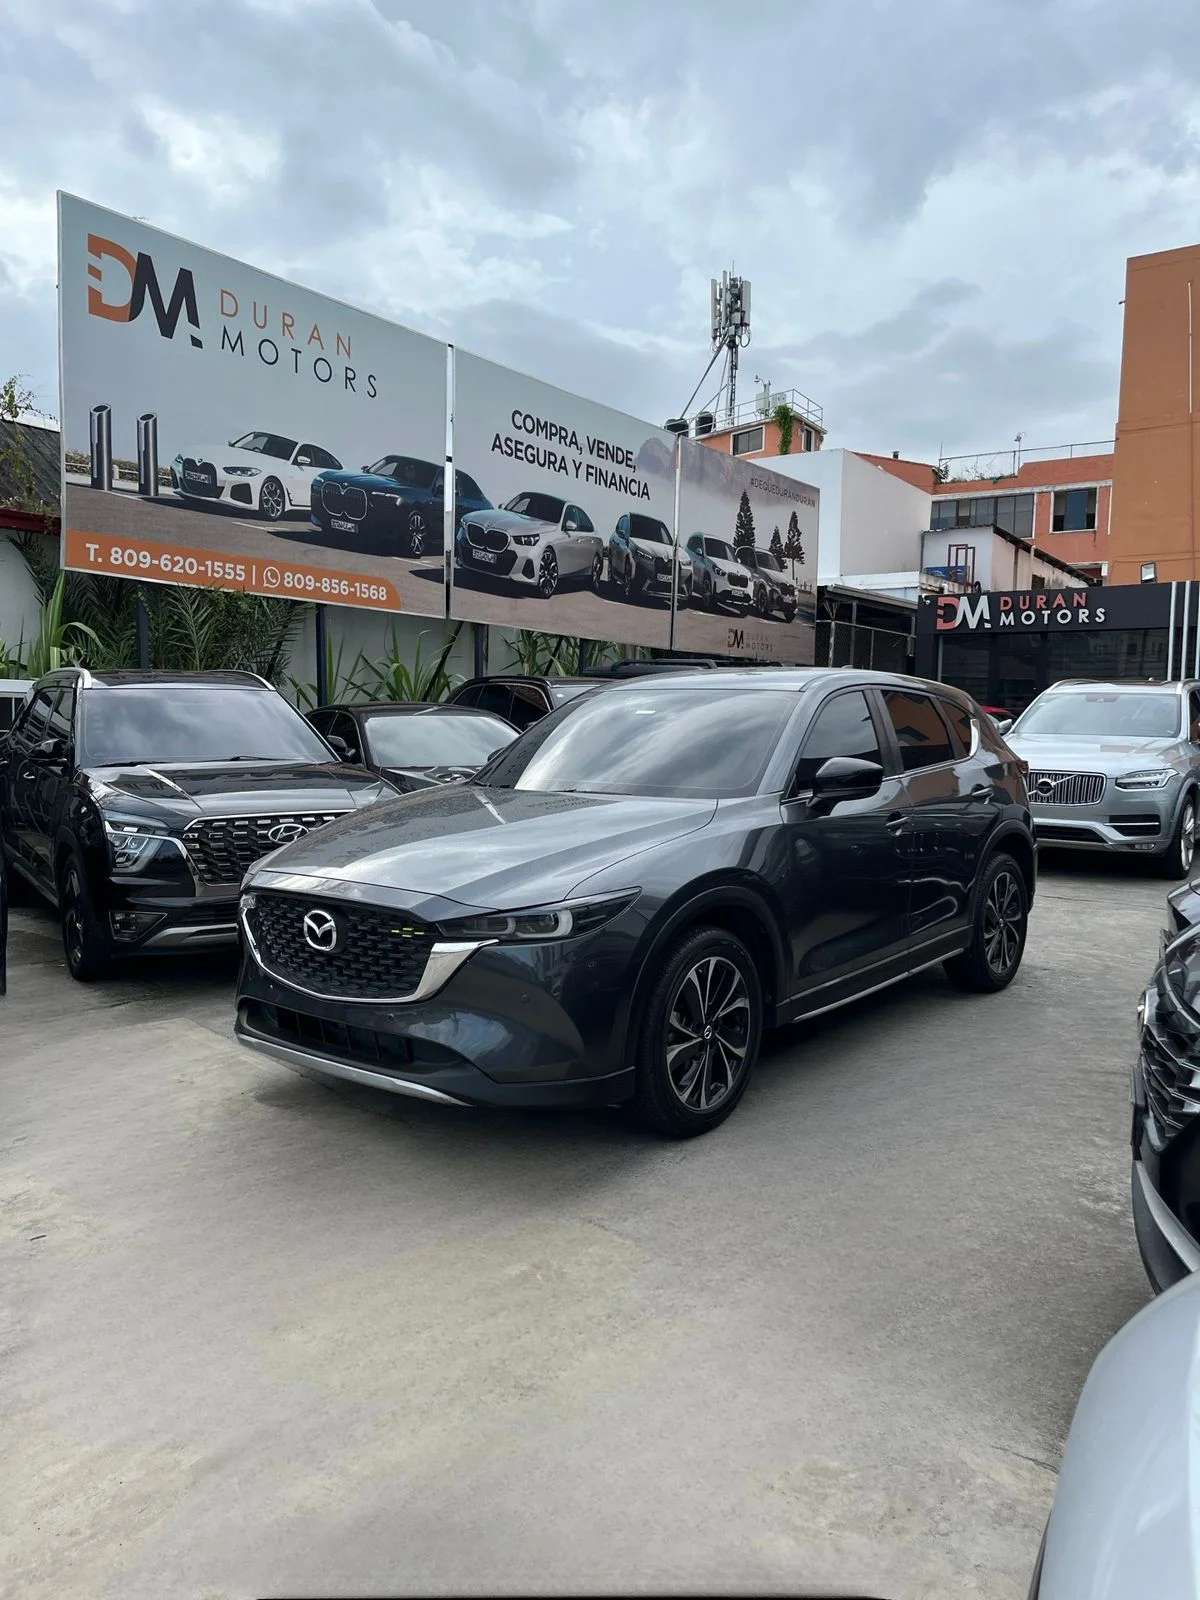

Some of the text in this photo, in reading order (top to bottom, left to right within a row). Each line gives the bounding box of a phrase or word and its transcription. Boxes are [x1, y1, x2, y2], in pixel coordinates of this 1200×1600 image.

[88, 233, 203, 349] DM
[220, 289, 352, 360] DURAN
[221, 325, 377, 398] MOTORS
[491, 433, 651, 500] ASEGURA Y FINANCIA
[511, 409, 637, 473] COMPRA, VENDE,
[85, 543, 387, 601] T. 809-620-1555 809-856-1568
[1000, 592, 1088, 611] DURAN
[936, 595, 992, 630] DM
[1000, 607, 1107, 626] MOTORS
